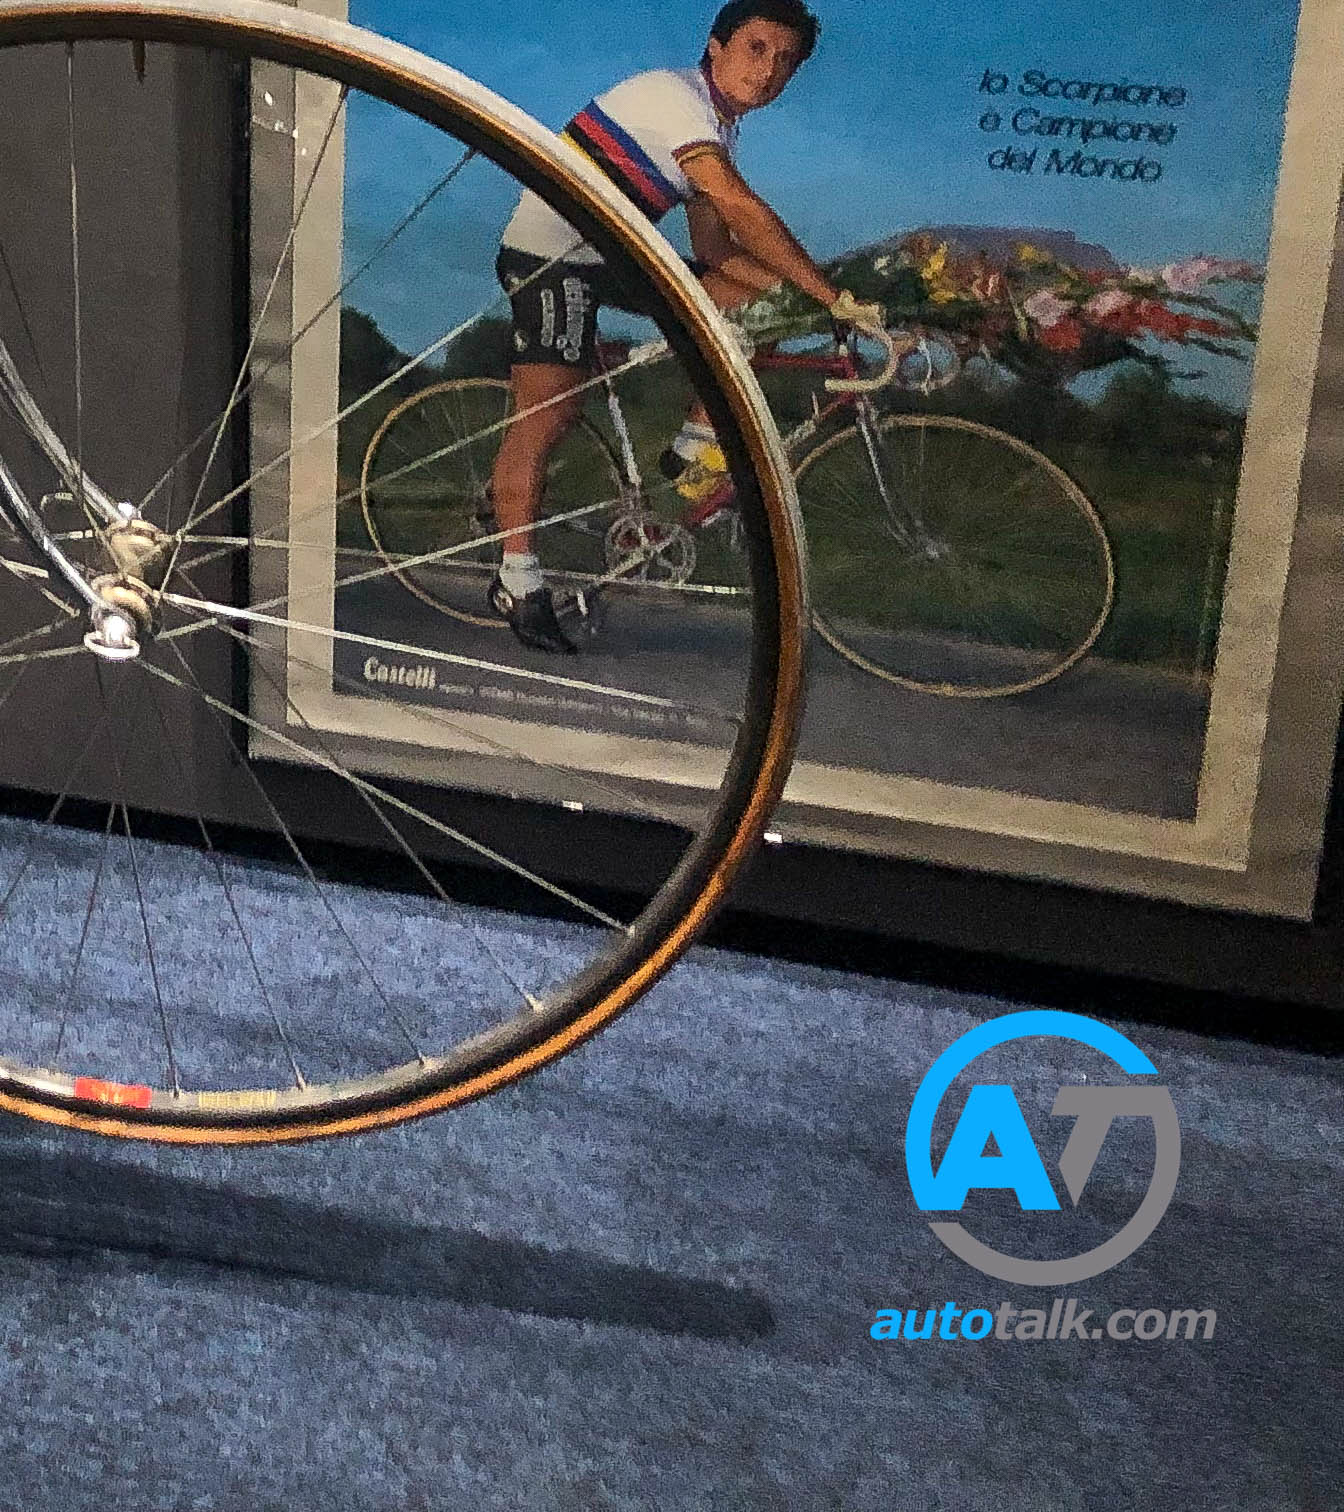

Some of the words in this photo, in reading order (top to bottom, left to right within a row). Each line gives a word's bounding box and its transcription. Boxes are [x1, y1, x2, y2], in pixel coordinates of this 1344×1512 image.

[1018, 69, 1188, 108] Scorpione
[1013, 106, 1179, 146] Campione
[987, 144, 1037, 176] del
[1045, 148, 1164, 183] Mondo
[363, 655, 437, 689] Castelli
